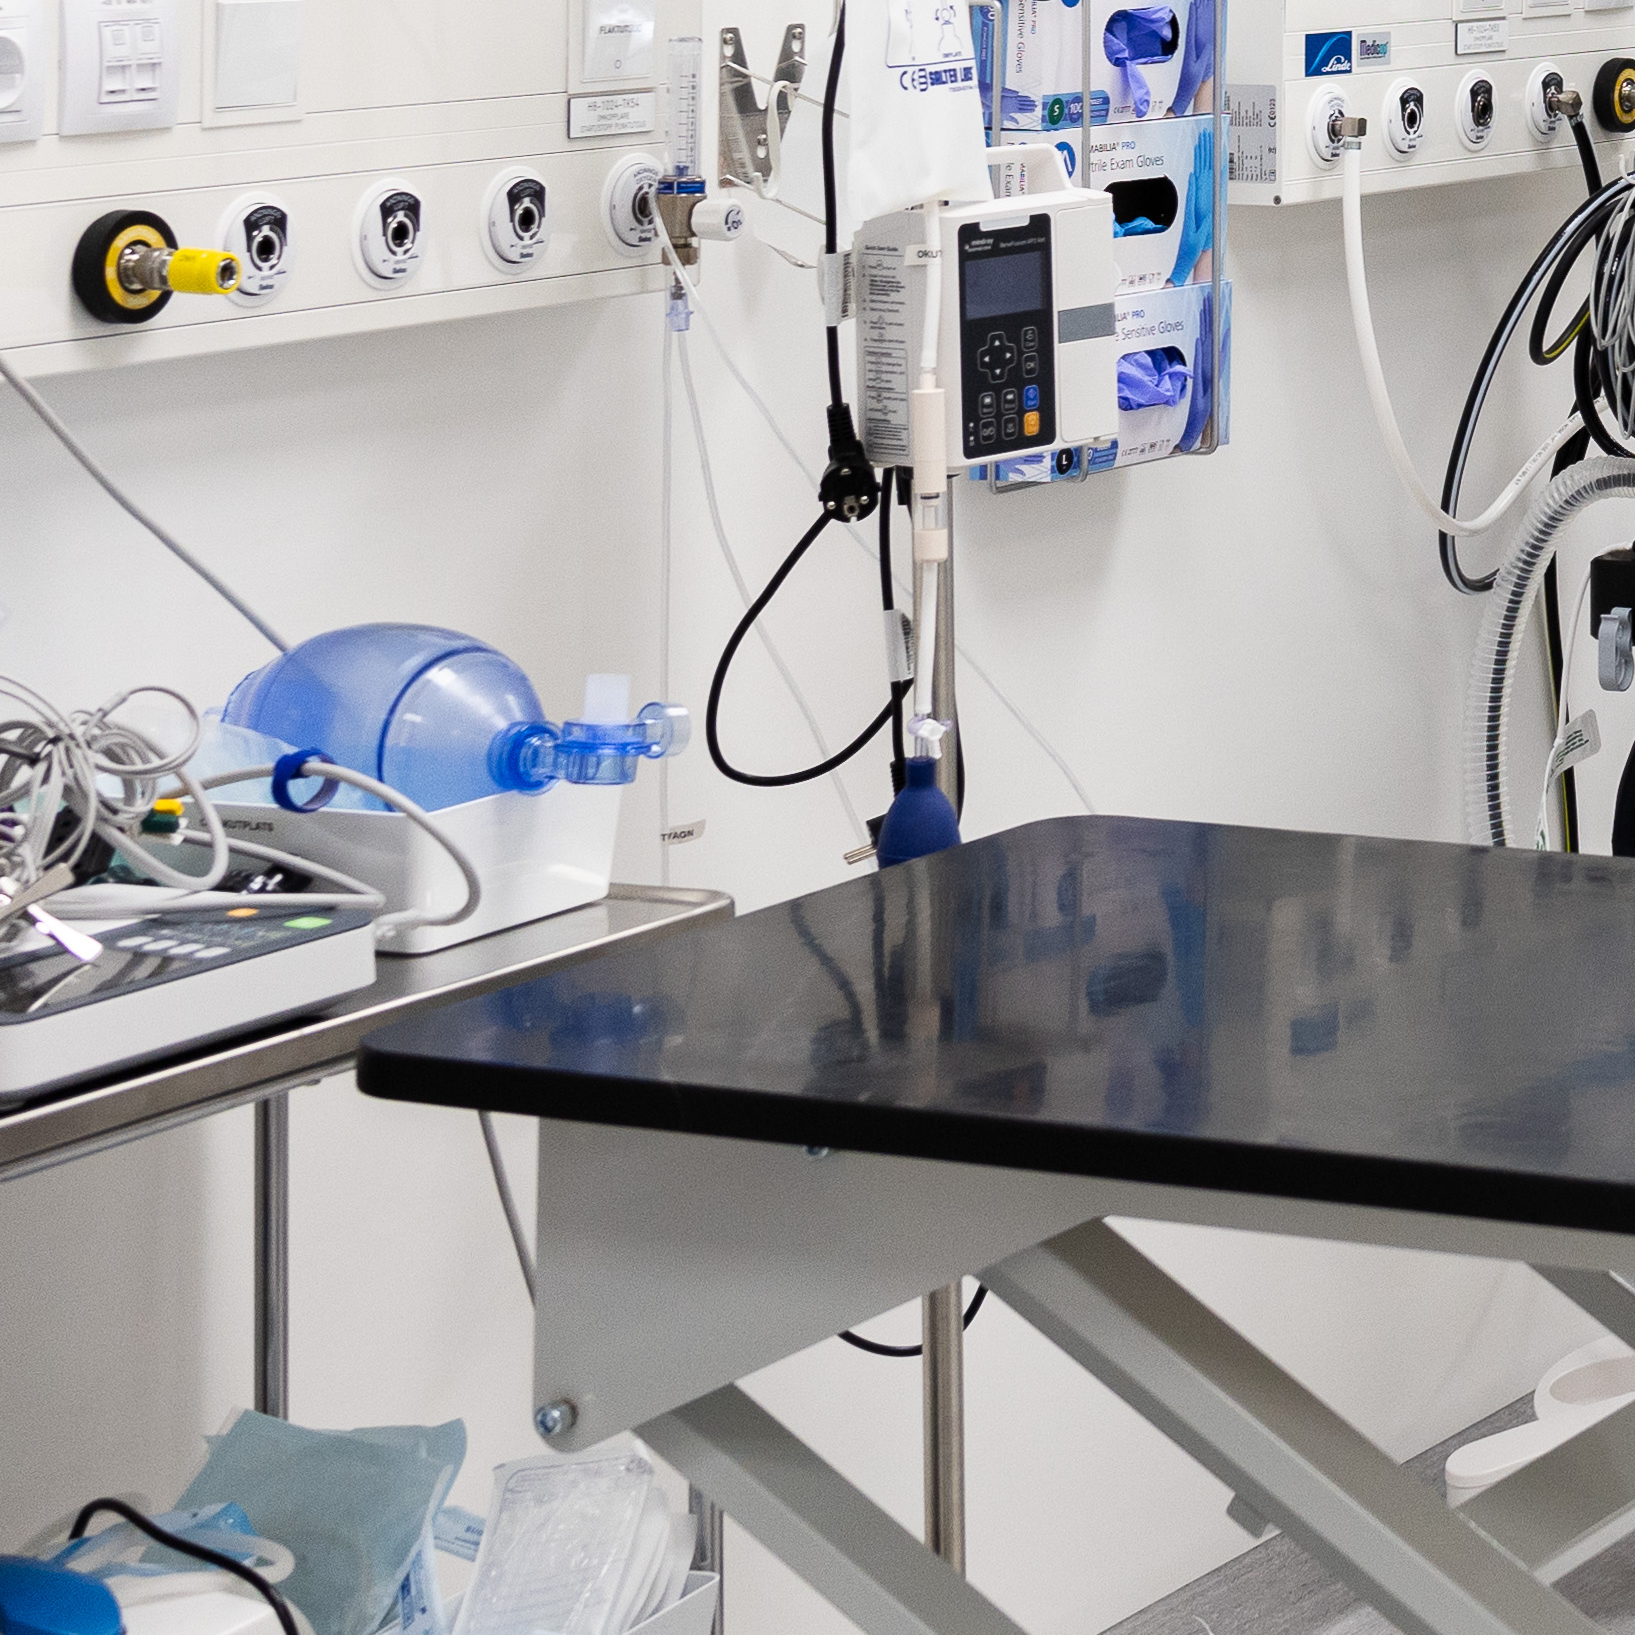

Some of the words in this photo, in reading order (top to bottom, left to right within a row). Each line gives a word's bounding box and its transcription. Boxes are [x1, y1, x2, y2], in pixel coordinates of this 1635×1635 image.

[1016, 41, 1026, 74] Gloves
[1321, 55, 1352, 73] Linde
[1121, 140, 1136, 151] PRO
[1091, 159, 1108, 173] trile
[1110, 157, 1134, 171] Exam
[1136, 154, 1165, 168] Gloves
[1131, 309, 1146, 319] PRO
[1121, 324, 1156, 341] Sensitive
[1158, 319, 1185, 334] Gloves
